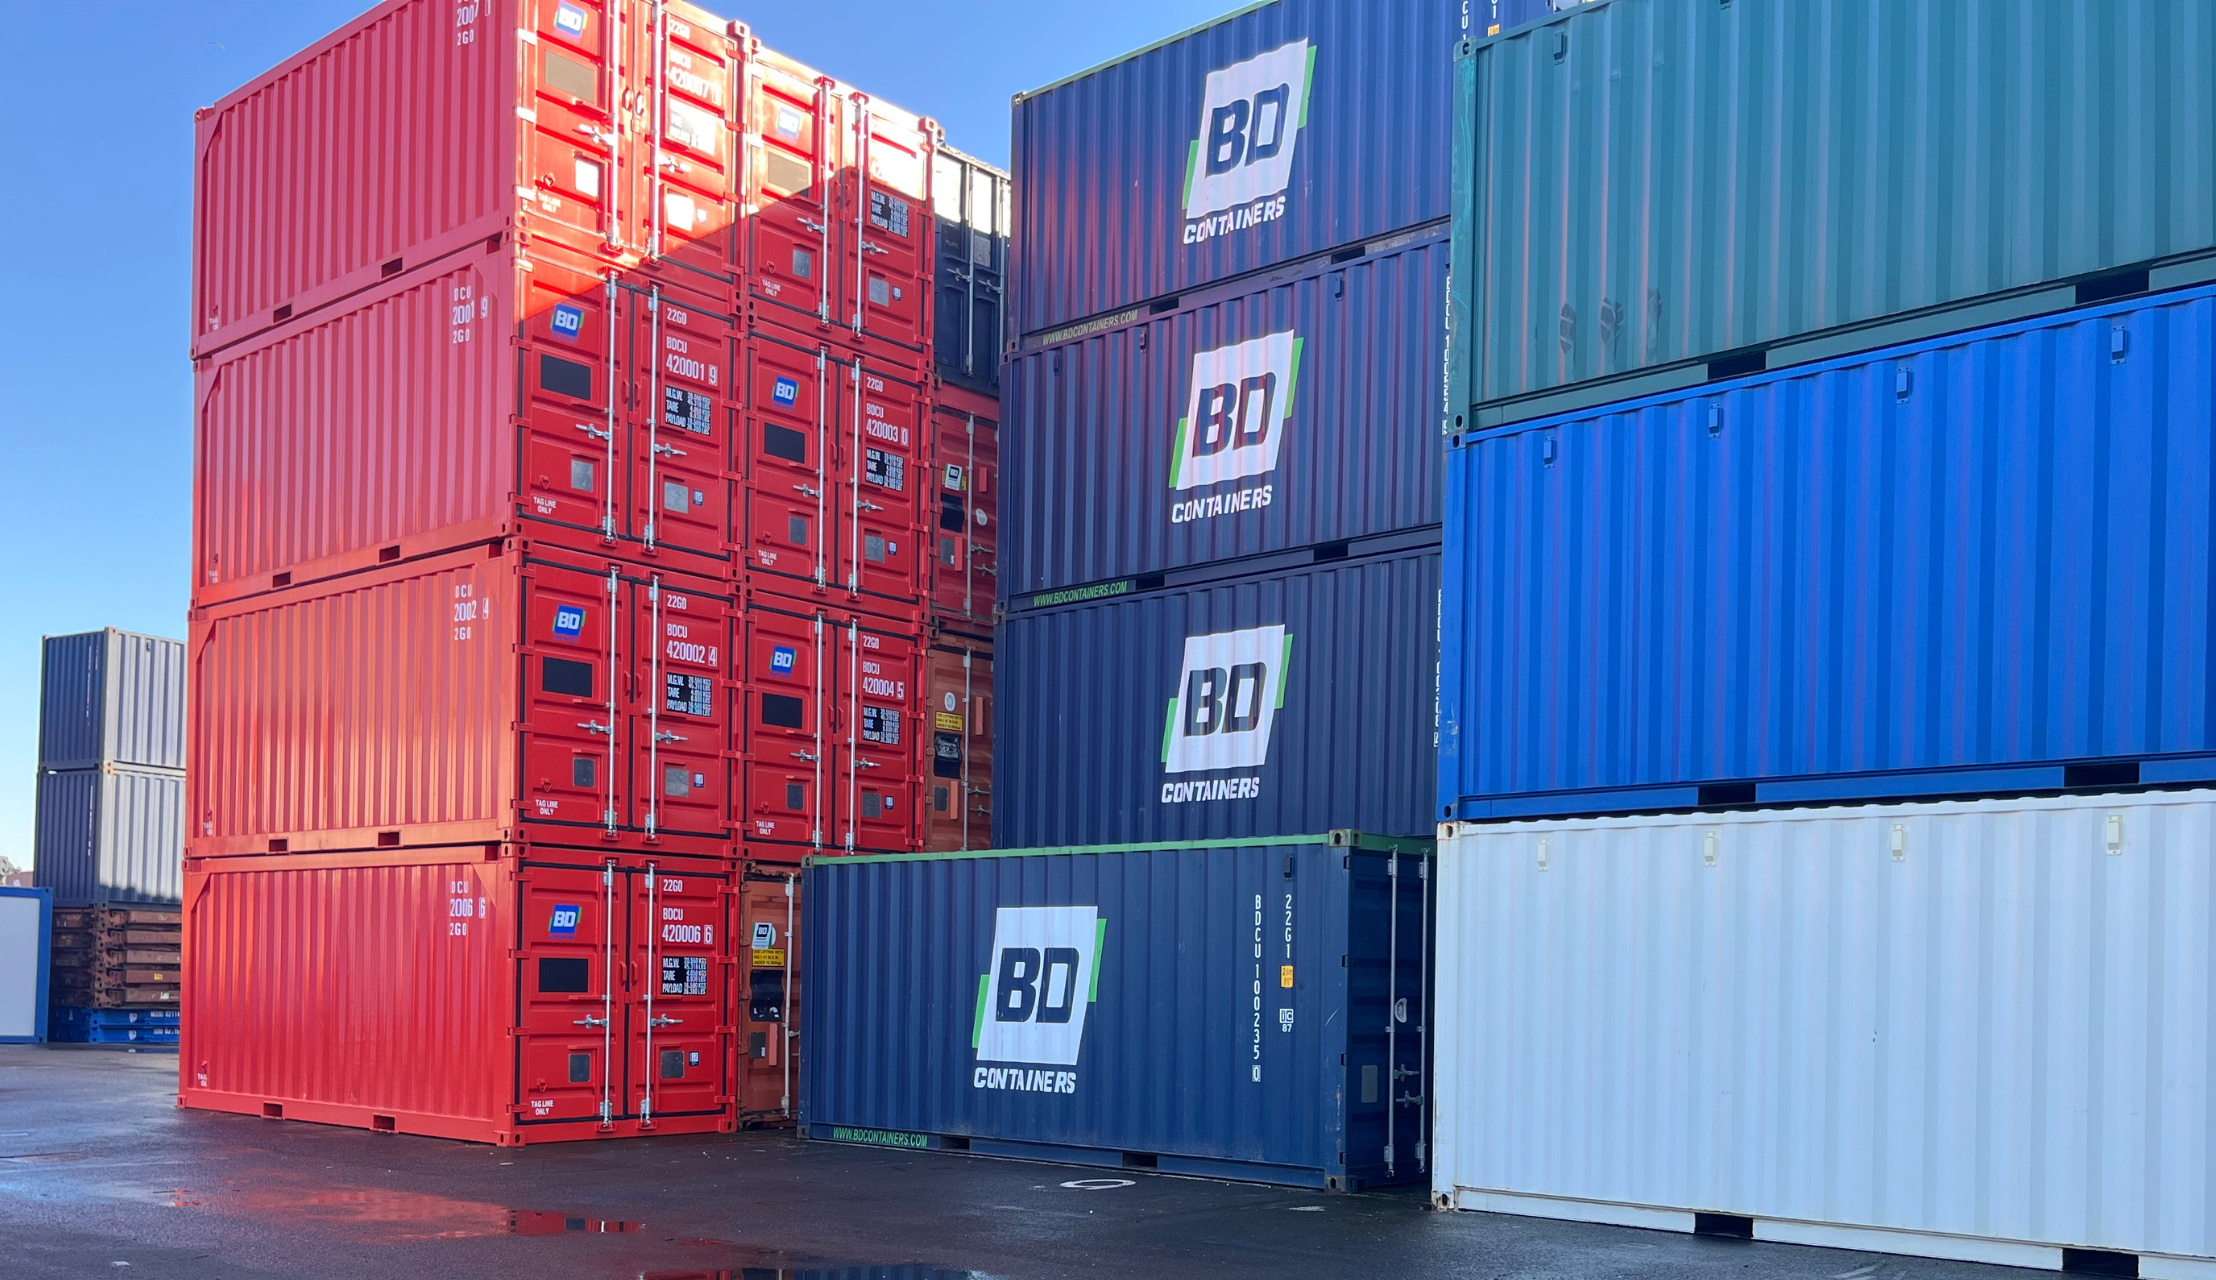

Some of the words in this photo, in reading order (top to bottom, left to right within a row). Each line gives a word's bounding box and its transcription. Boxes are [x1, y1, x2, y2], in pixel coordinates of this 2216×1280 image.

[1205, 83, 1290, 180] BD
[1183, 196, 1286, 245] CONTAINERS
[453, 300, 475, 326] 2001
[481, 296, 488, 318] 9
[555, 310, 579, 331] BD
[1042, 309, 1138, 346] WWW.BDCONTAINERS.COM
[667, 336, 687, 353] BDCU
[666, 352, 704, 380] 420001
[709, 365, 717, 386] 9
[775, 382, 795, 400] BD
[867, 403, 883, 418] BDCU
[1191, 371, 1277, 459] BD
[866, 417, 898, 442] 420003
[534, 497, 544, 506] TAG
[544, 499, 556, 508] LINE
[538, 506, 552, 514] ONLY
[1171, 485, 1273, 524] CONTAINERS
[1033, 580, 1128, 608] WWW.BDCONTAINERS.COM
[454, 600, 476, 621] 2002
[483, 598, 489, 619] 4
[557, 611, 581, 630] BD
[667, 623, 687, 638] BDCU
[667, 640, 705, 663] 420002
[709, 646, 717, 667] 4
[773, 651, 793, 668] BD
[863, 662, 879, 674] BDCU
[863, 677, 894, 696] 420004
[897, 682, 904, 699] 5
[1183, 661, 1268, 738] BD
[1161, 776, 1260, 804] CONTAINERS
[536, 799, 546, 808] TAG
[547, 800, 558, 808] LINE
[450, 898, 473, 916] 2006
[479, 897, 485, 918] 6
[663, 908, 683, 920] BDCU
[553, 911, 576, 927] BD
[1284, 894, 1292, 958] 22G1
[662, 924, 701, 943] 420006
[704, 925, 713, 944] 6
[995, 947, 1080, 1024] BD
[1253, 964, 1261, 1060] 100235
[1282, 1024, 1292, 1032] 87
[973, 1067, 1077, 1094] CONTAINERS
[542, 1100, 554, 1108] LINE
[833, 1126, 928, 1148] WWW.BDCONTAINERS.COM
